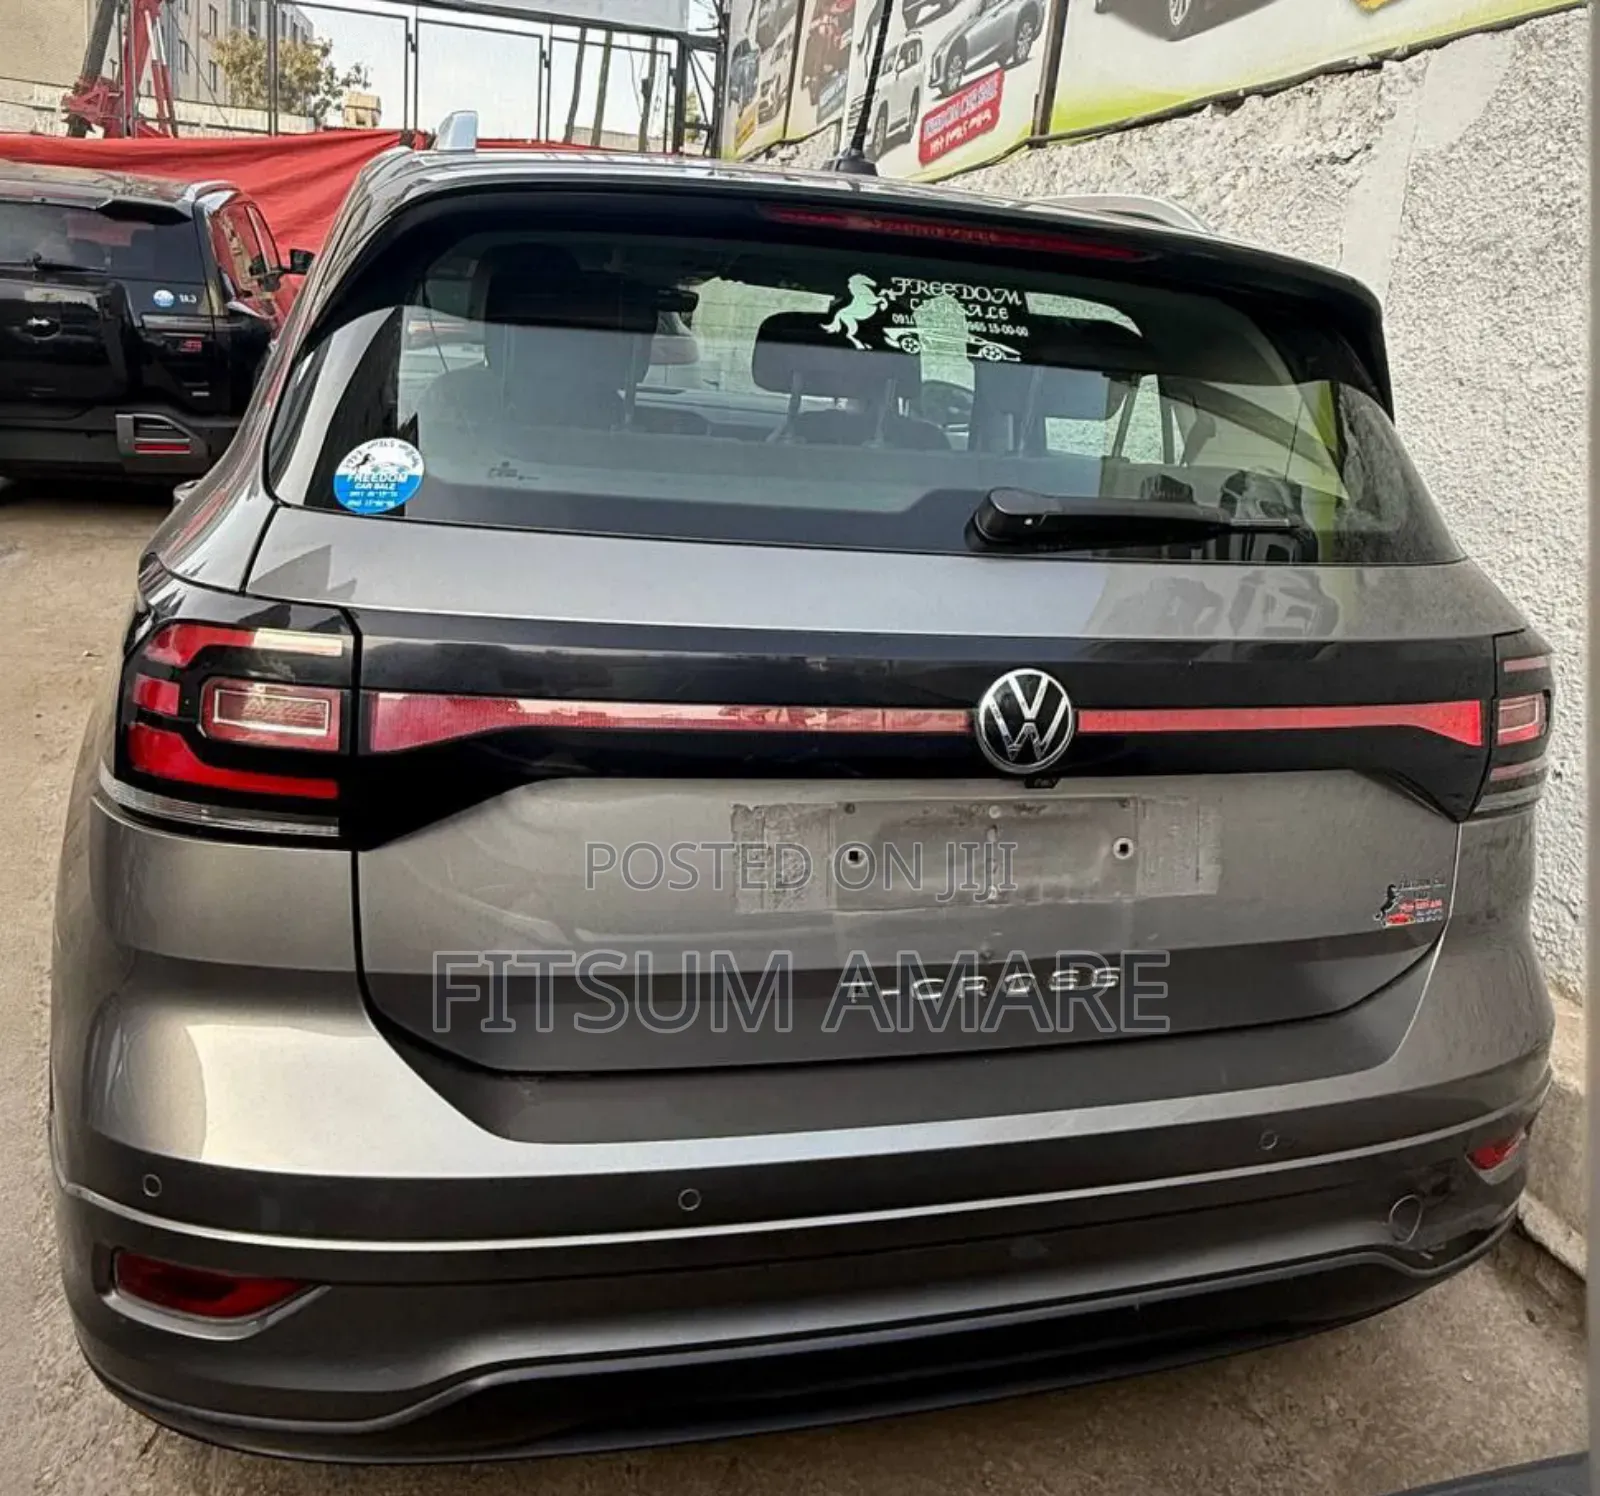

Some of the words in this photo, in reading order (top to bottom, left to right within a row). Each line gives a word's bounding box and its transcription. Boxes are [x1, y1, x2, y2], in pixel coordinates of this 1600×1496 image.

[891, 277, 1022, 306] FREEDOM
[346, 471, 408, 483] FREEDOM
[841, 967, 1120, 1003] T-CROSS
